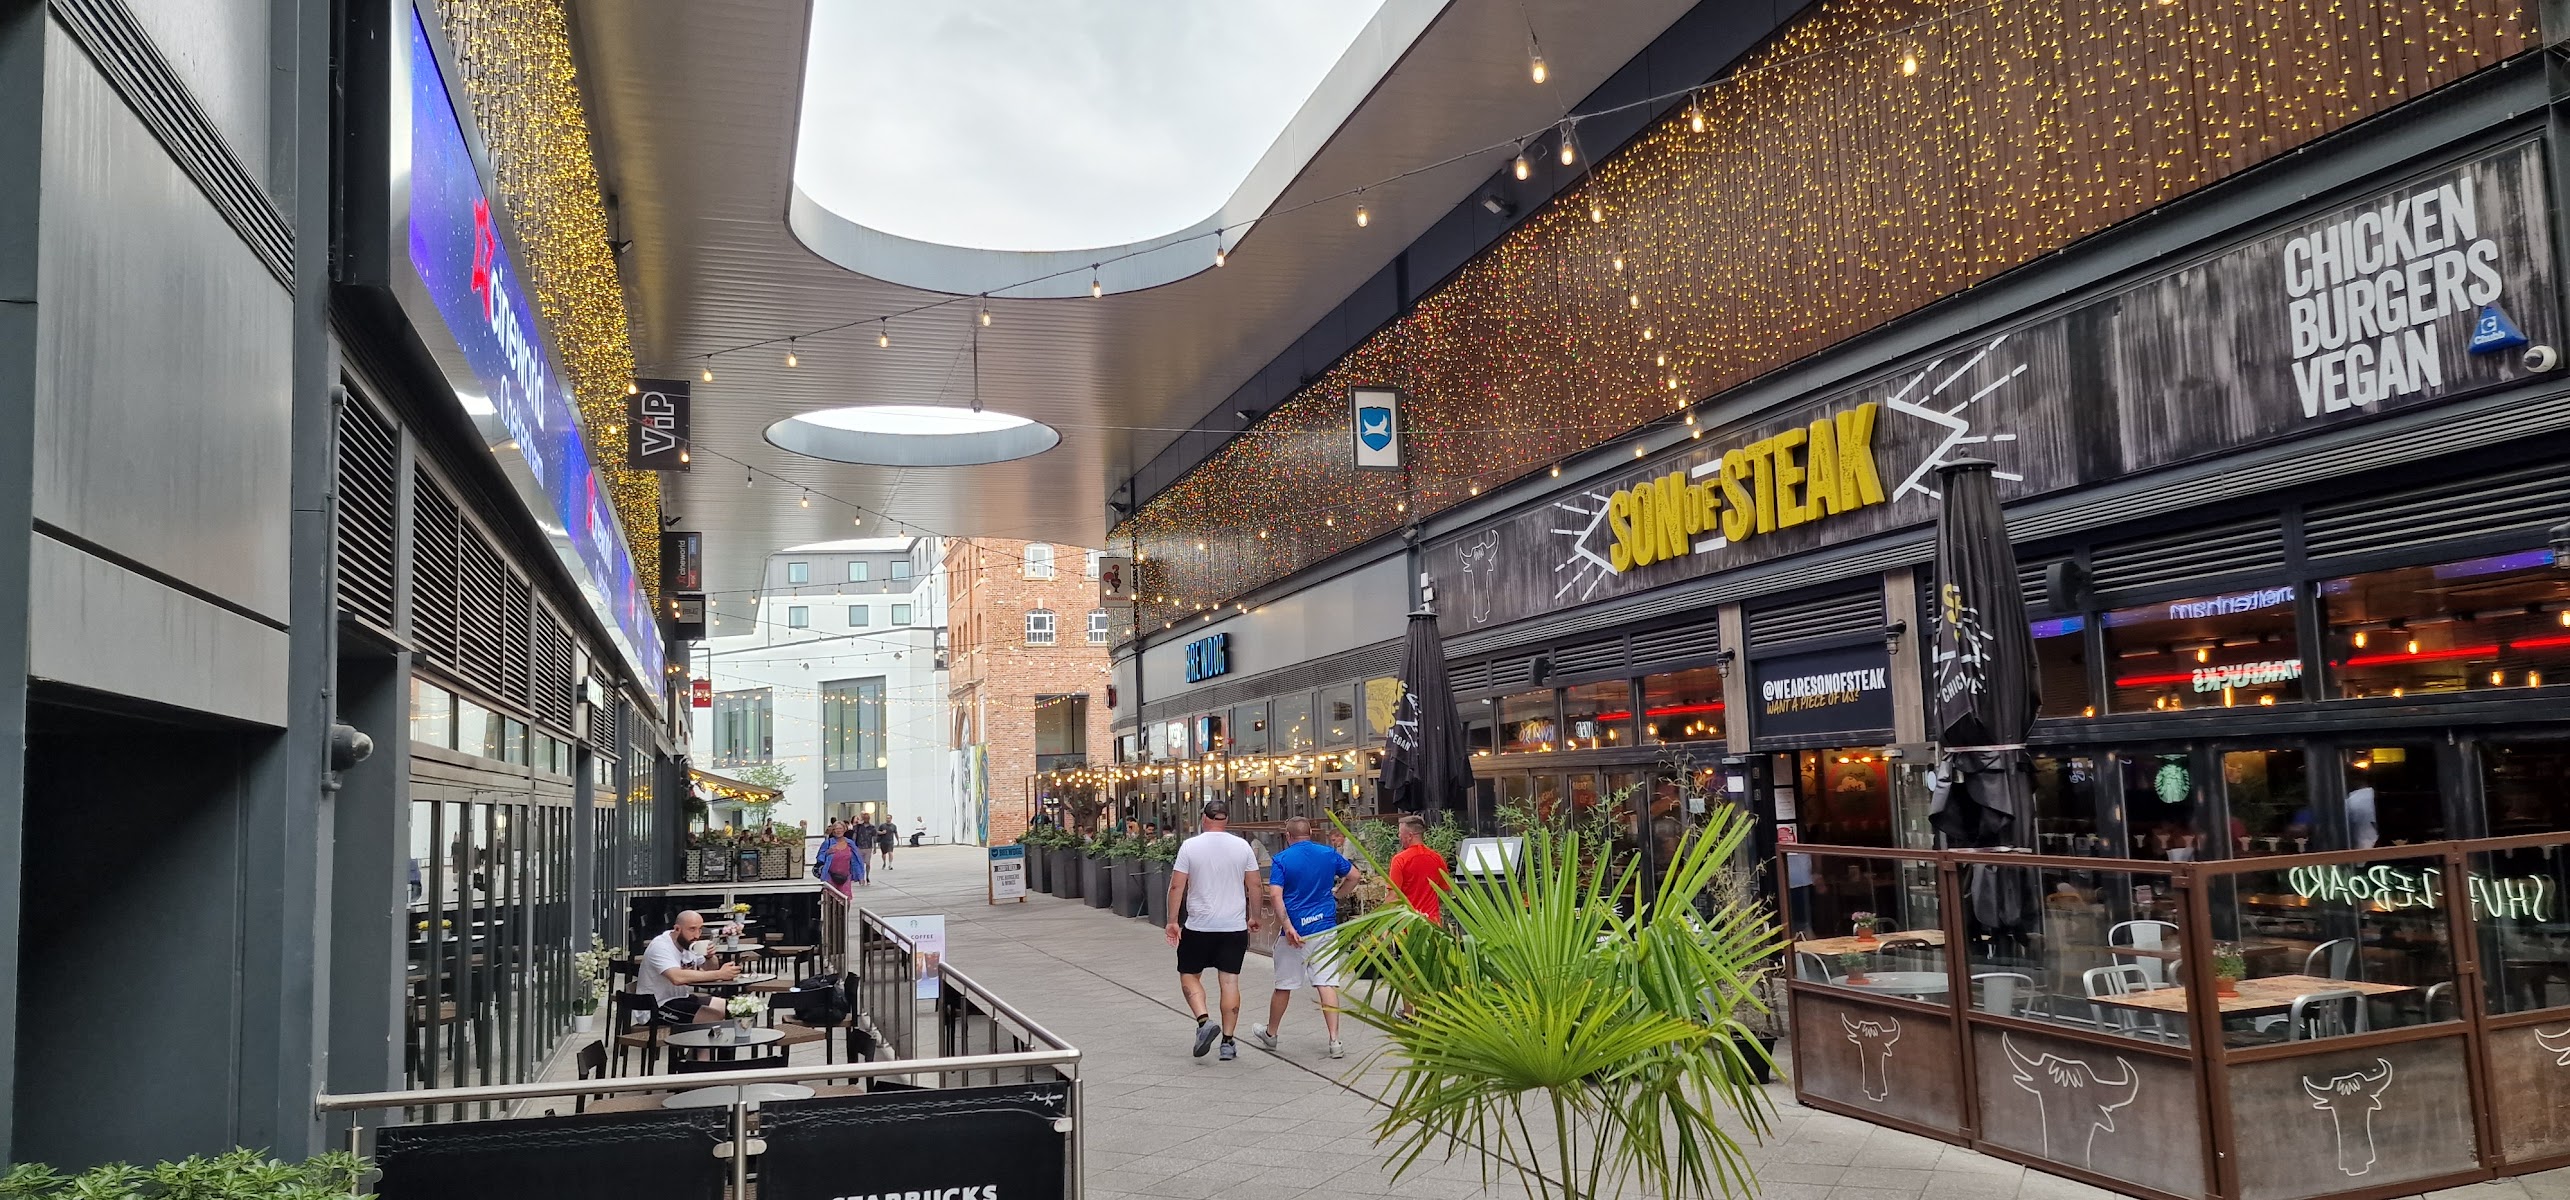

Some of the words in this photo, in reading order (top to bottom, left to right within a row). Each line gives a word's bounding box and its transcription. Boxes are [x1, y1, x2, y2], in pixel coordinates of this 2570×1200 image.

[2284, 176, 2478, 298] CHICKEN
[490, 264, 545, 432] cineworld
[2289, 239, 2502, 359] BURGERS
[2291, 324, 2442, 418] VEGAN
[501, 374, 544, 490] Cheltenham
[1609, 471, 1689, 572] SON
[1684, 478, 1722, 535] OF
[1720, 402, 1885, 542] STEAK
[678, 540, 686, 576] cineworld
[1185, 633, 1227, 683] BREWDOG
[1763, 668, 1887, 701] @WEARESONOFSTEAK
[1766, 698, 1792, 715] WANT
[1791, 698, 1798, 712] A
[1800, 693, 1826, 710] PIECE
[1828, 692, 1840, 706] OF
